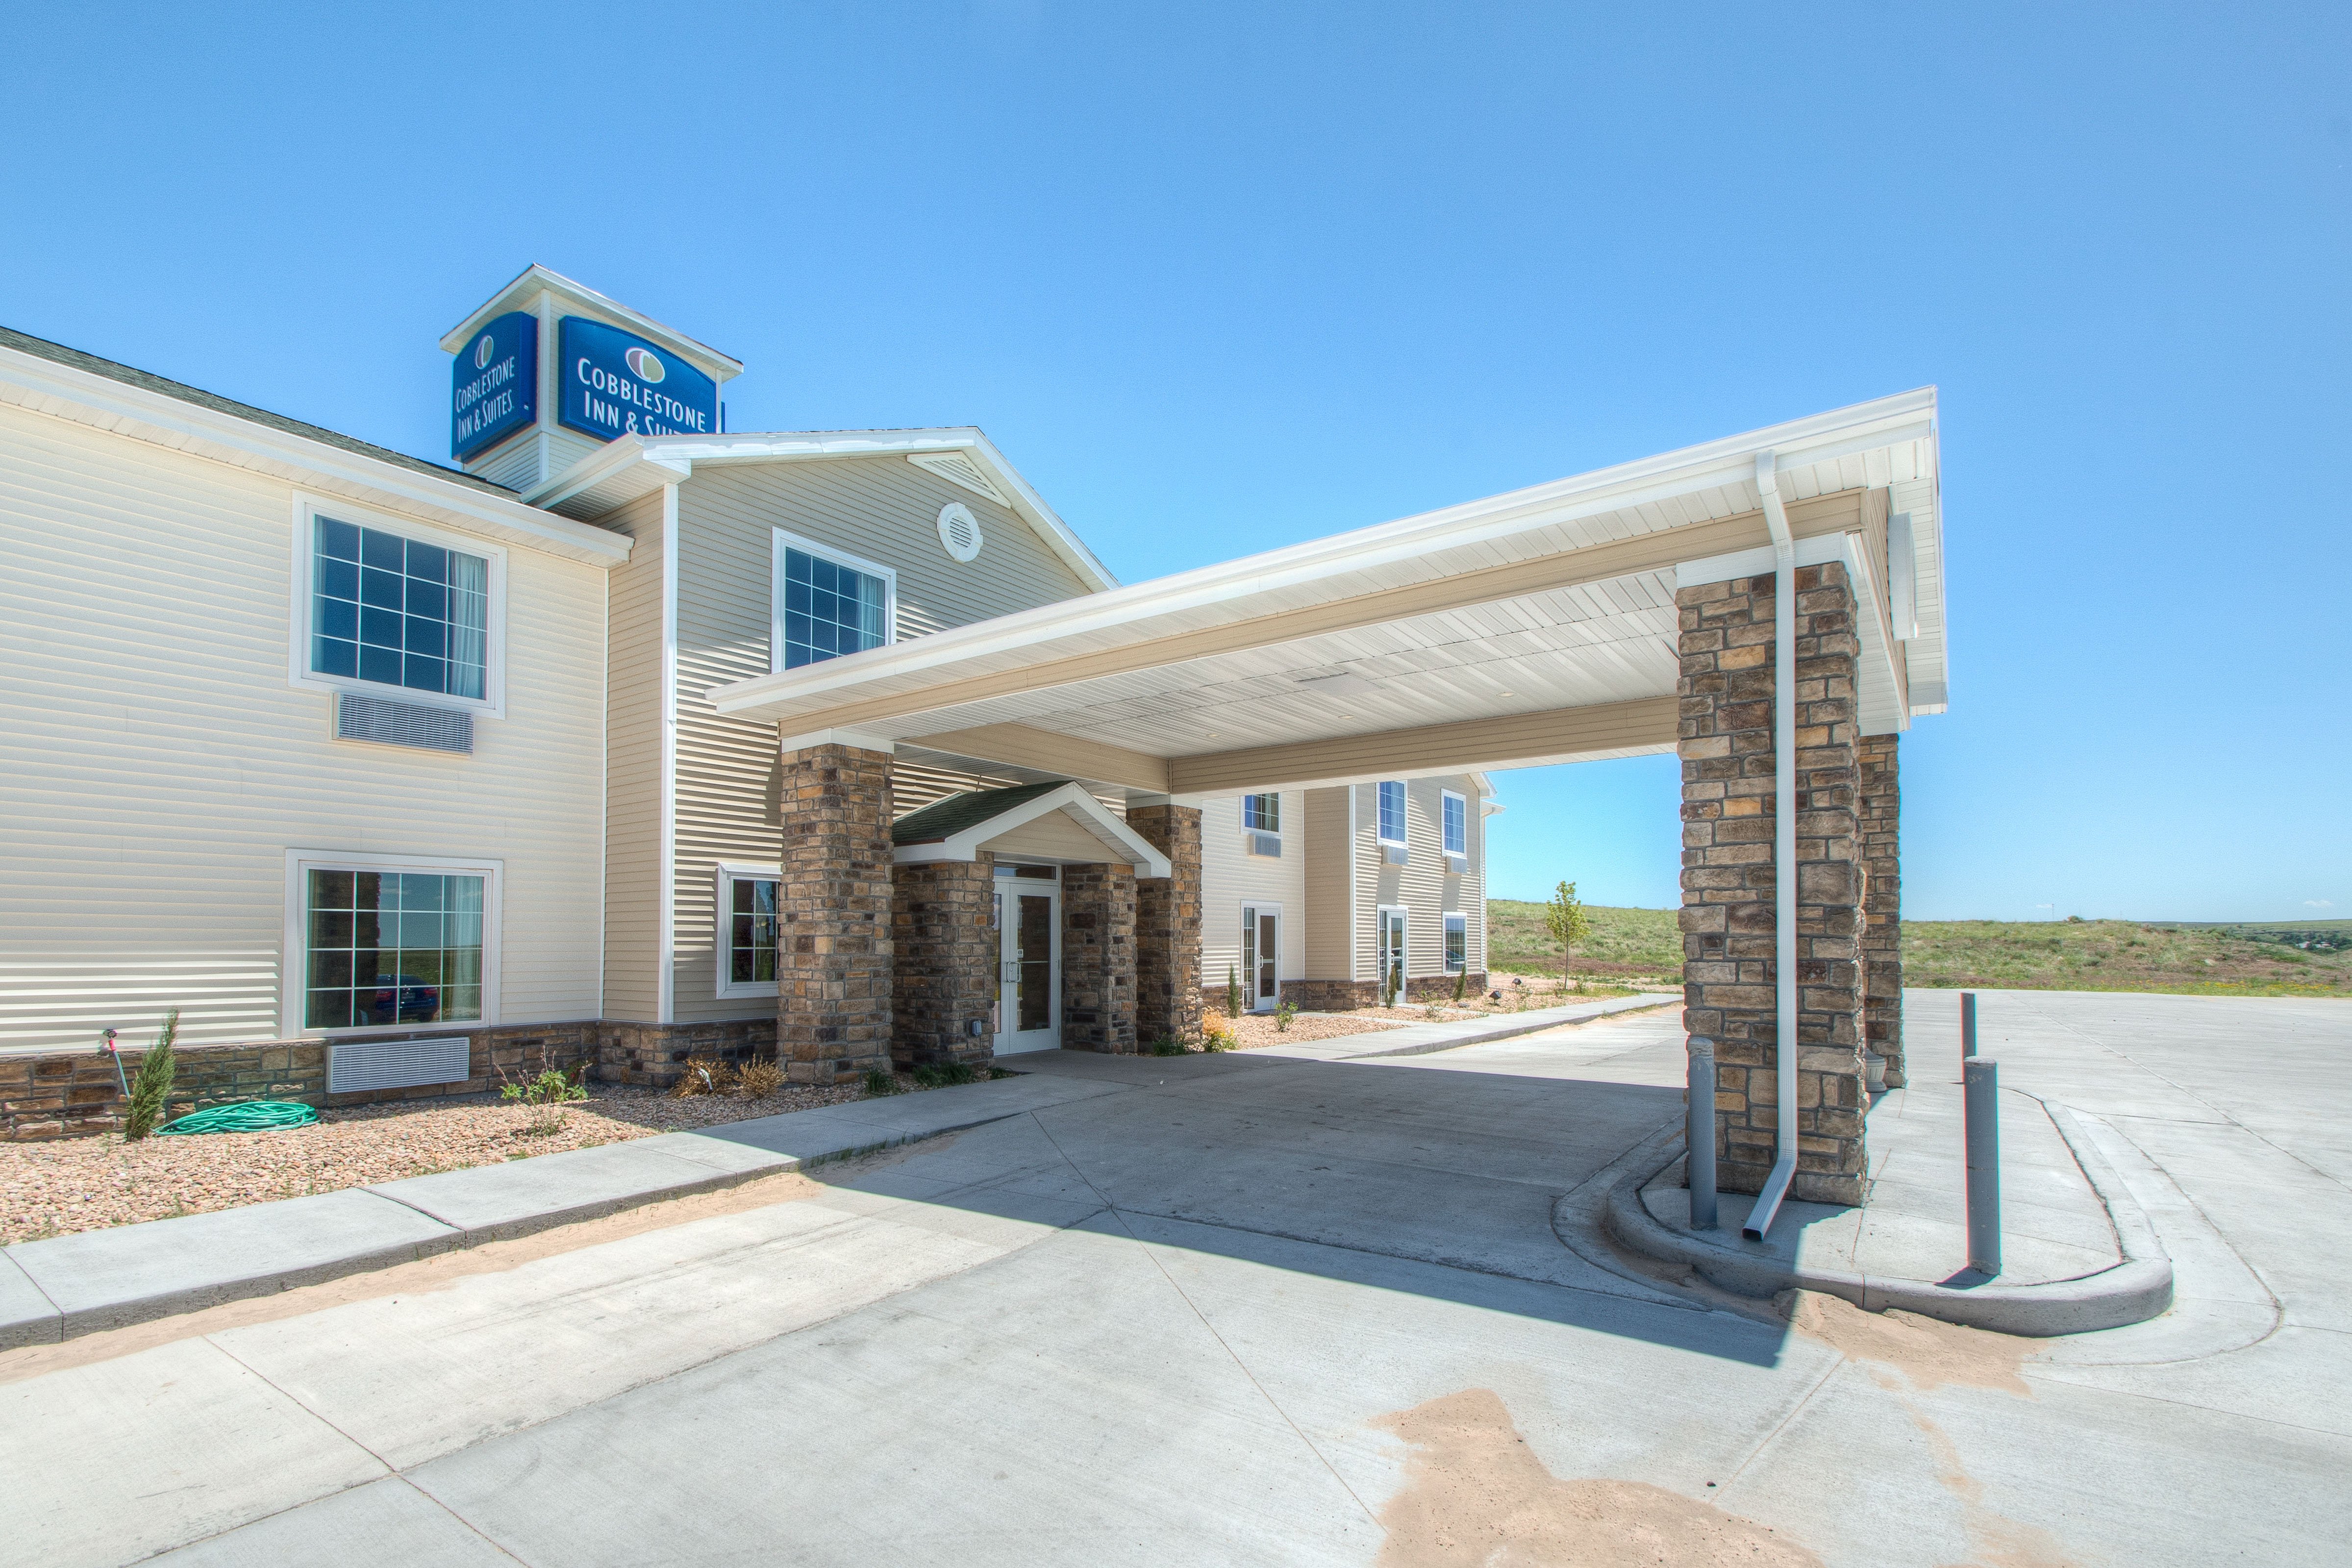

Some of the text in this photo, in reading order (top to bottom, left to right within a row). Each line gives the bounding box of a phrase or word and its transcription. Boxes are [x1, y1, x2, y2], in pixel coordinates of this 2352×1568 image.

[455, 356, 515, 413] COBBLESTONE
[578, 357, 706, 433] COBBLESTONE
[457, 389, 512, 443] INN & SUITES
[585, 391, 619, 429] INN
[626, 411, 639, 434] &
